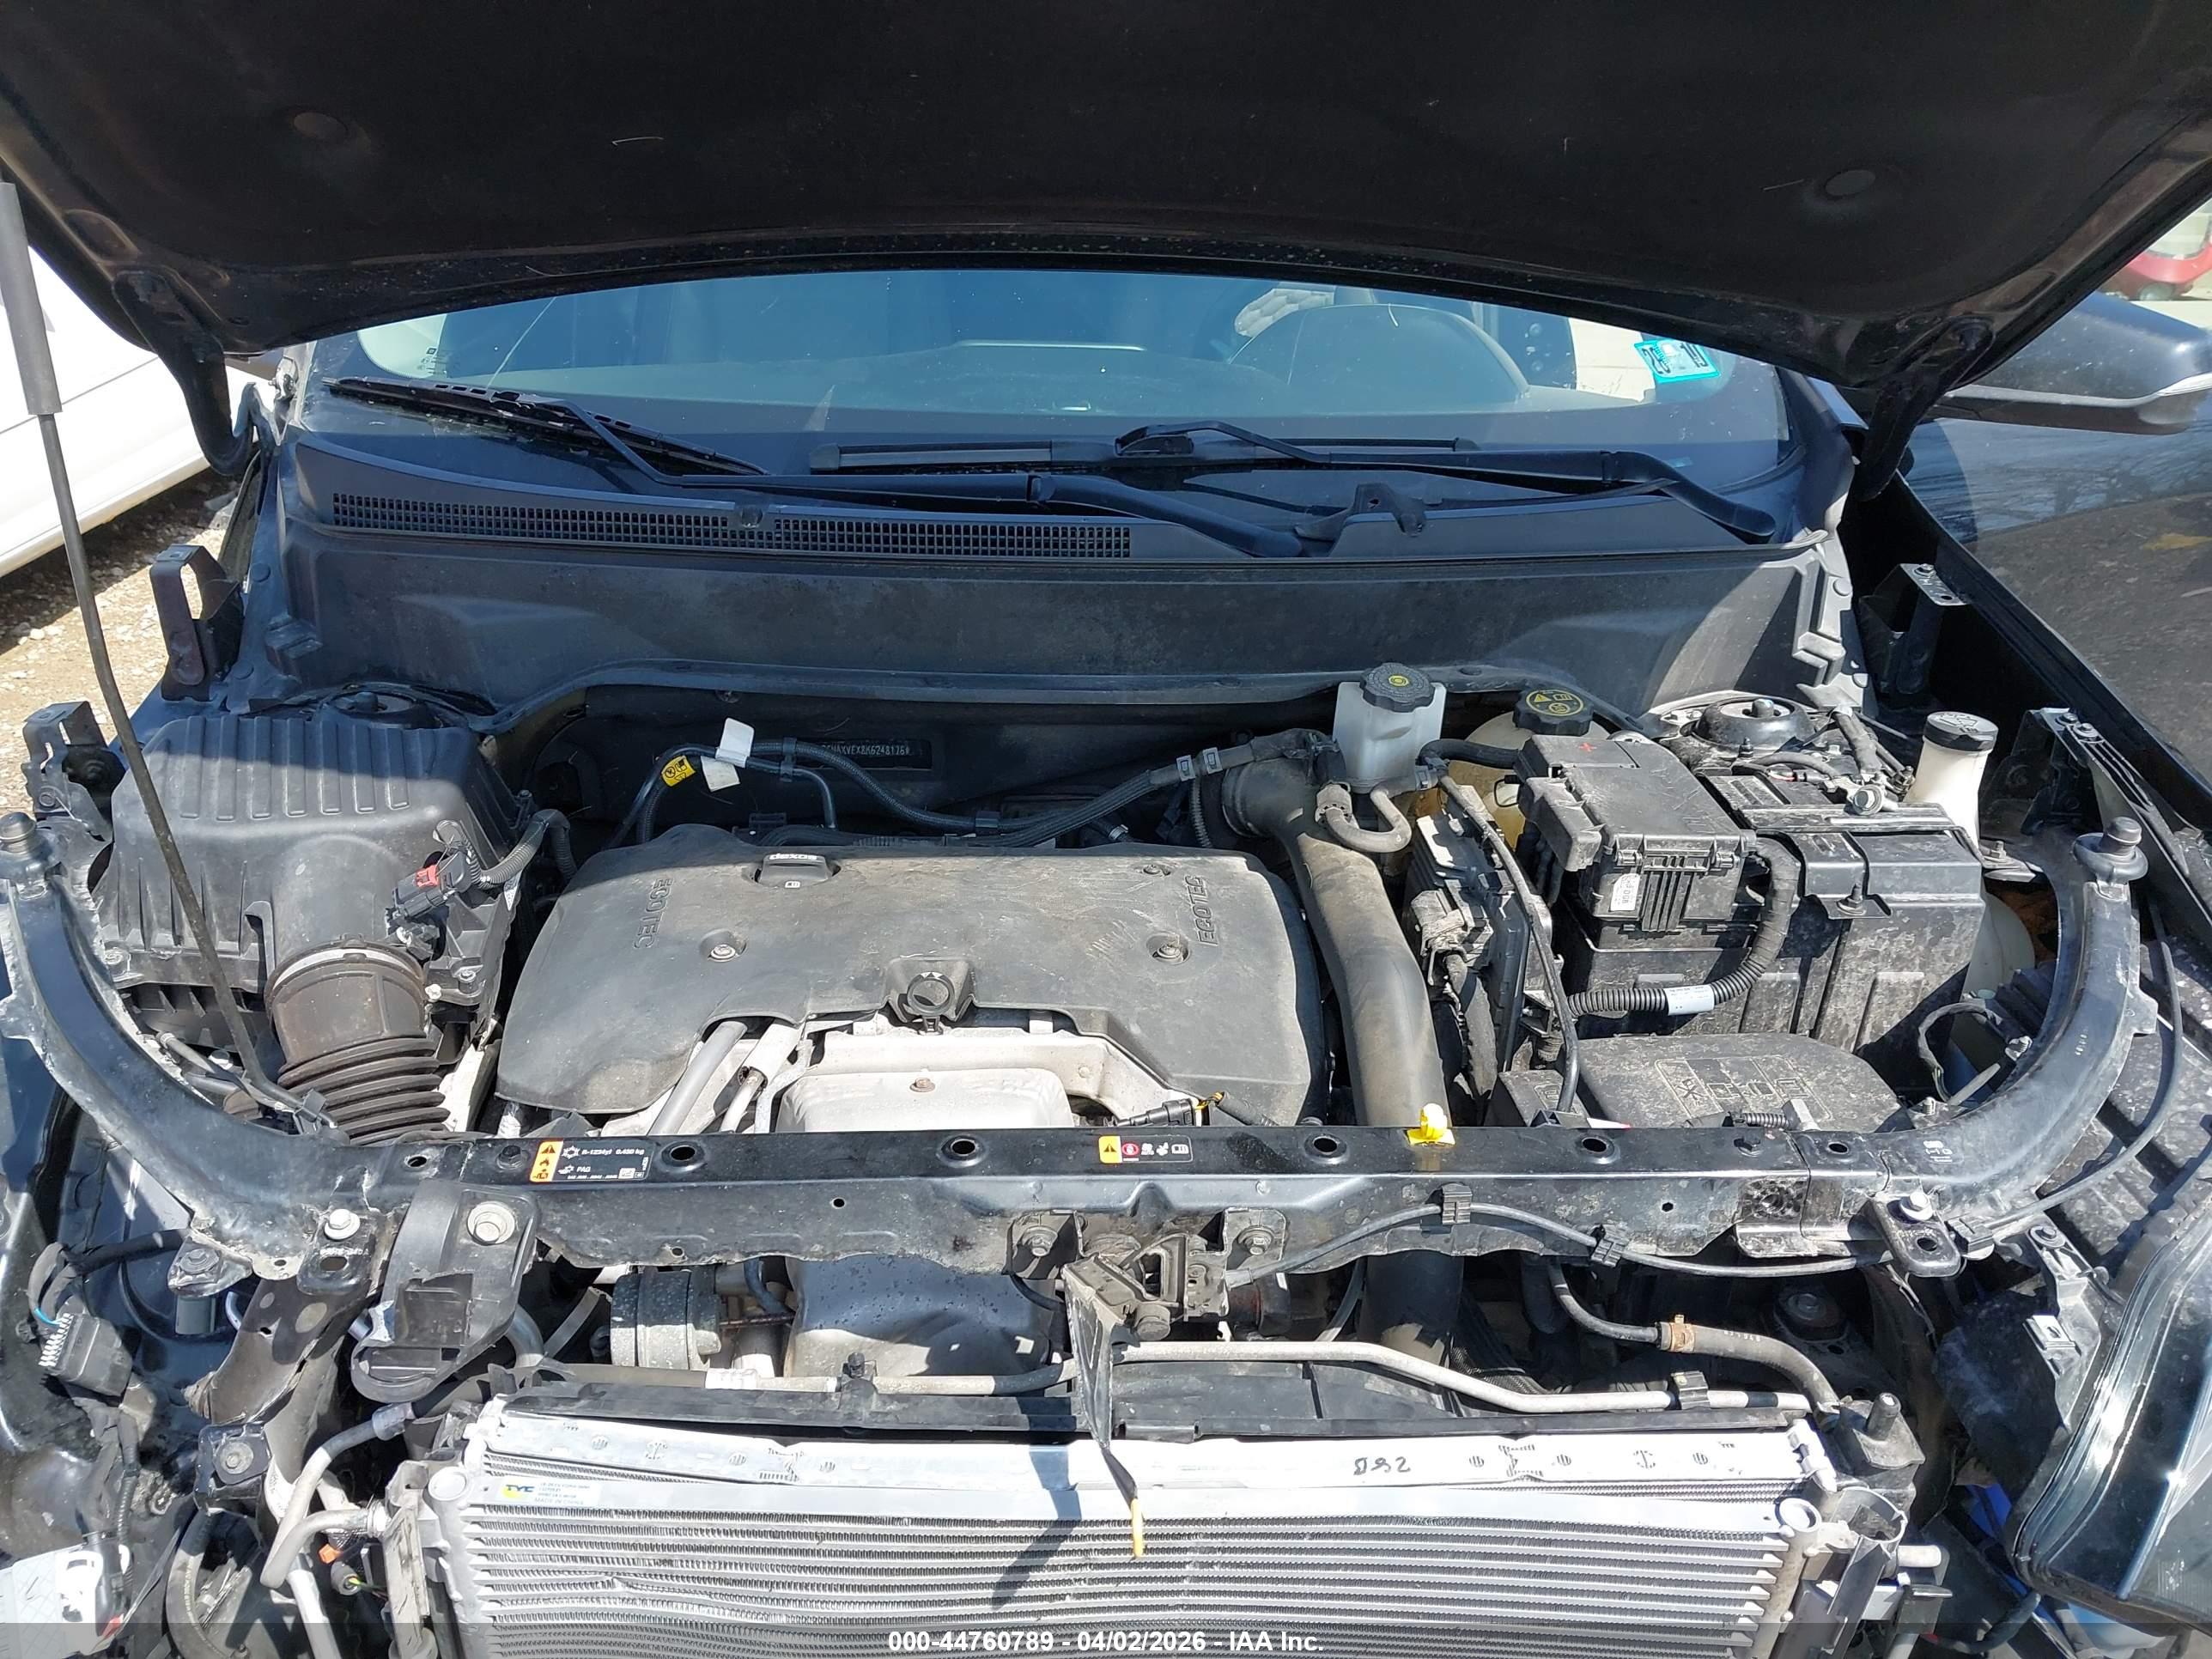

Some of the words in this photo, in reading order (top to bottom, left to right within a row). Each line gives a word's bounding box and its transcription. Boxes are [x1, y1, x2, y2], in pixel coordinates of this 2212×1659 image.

[634, 878, 673, 948] ECOTEC
[1185, 875, 1219, 947] ECOTEC
[505, 1484, 535, 1492] TYC
